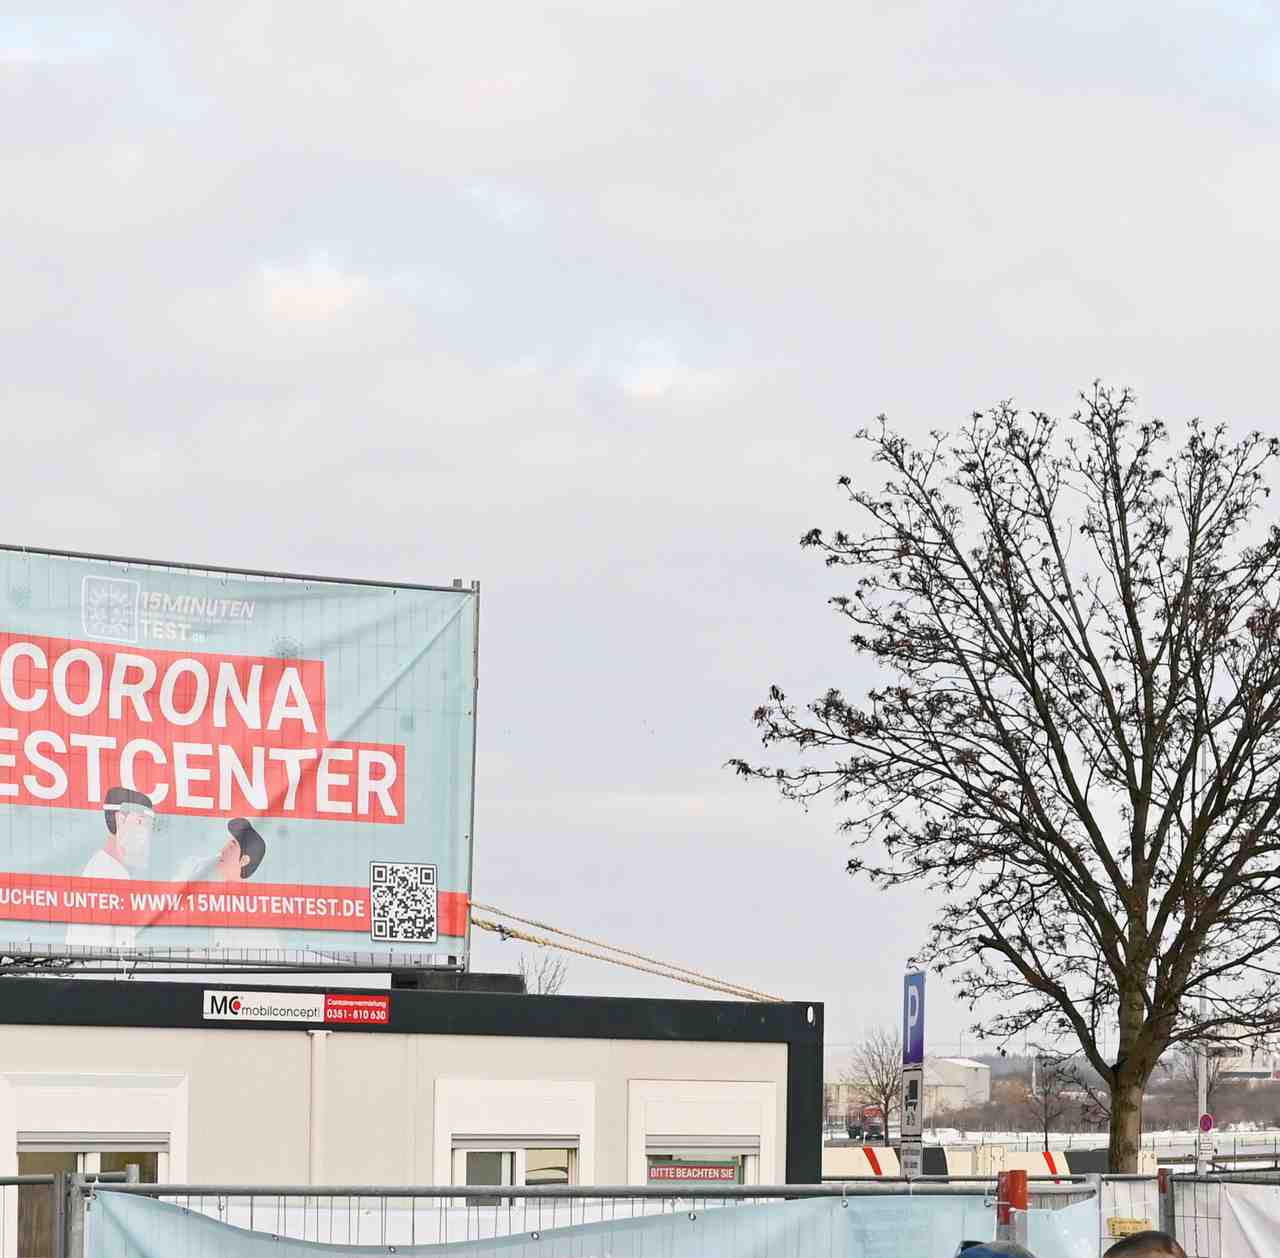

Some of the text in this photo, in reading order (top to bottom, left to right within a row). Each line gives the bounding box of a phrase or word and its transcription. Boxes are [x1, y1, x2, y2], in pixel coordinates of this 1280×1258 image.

[0, 642, 319, 733] CORONA
[64, 891, 125, 910] UNTER:
[130, 892, 365, 917] WWW.15MINUTENTEST.DE
[241, 1006, 318, 1019] mobilconcept
[651, 1167, 734, 1179] BITTE BEACHTEN SIE
